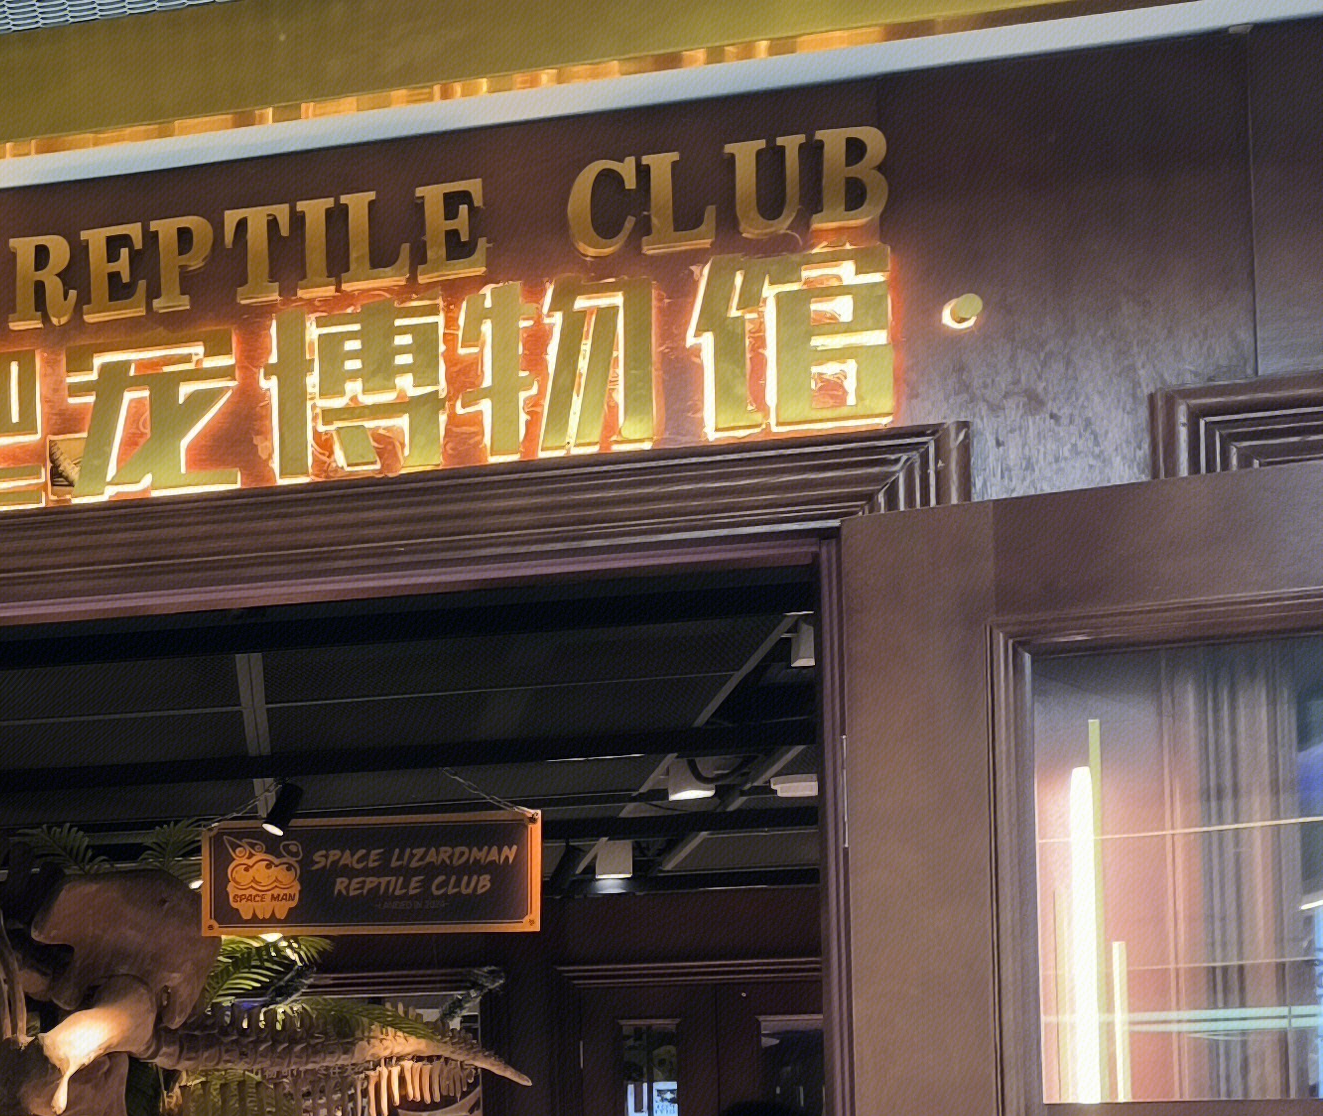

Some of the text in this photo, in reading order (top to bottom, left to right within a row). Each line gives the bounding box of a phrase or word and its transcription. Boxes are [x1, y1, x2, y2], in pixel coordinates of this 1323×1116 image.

[8, 177, 488, 331] REPTILE
[568, 125, 890, 257] CLUB
[311, 845, 518, 871] SPACE LIZARDMAN
[233, 892, 296, 903] SPACE MAN
[334, 874, 492, 898] REPTILE CLUB
